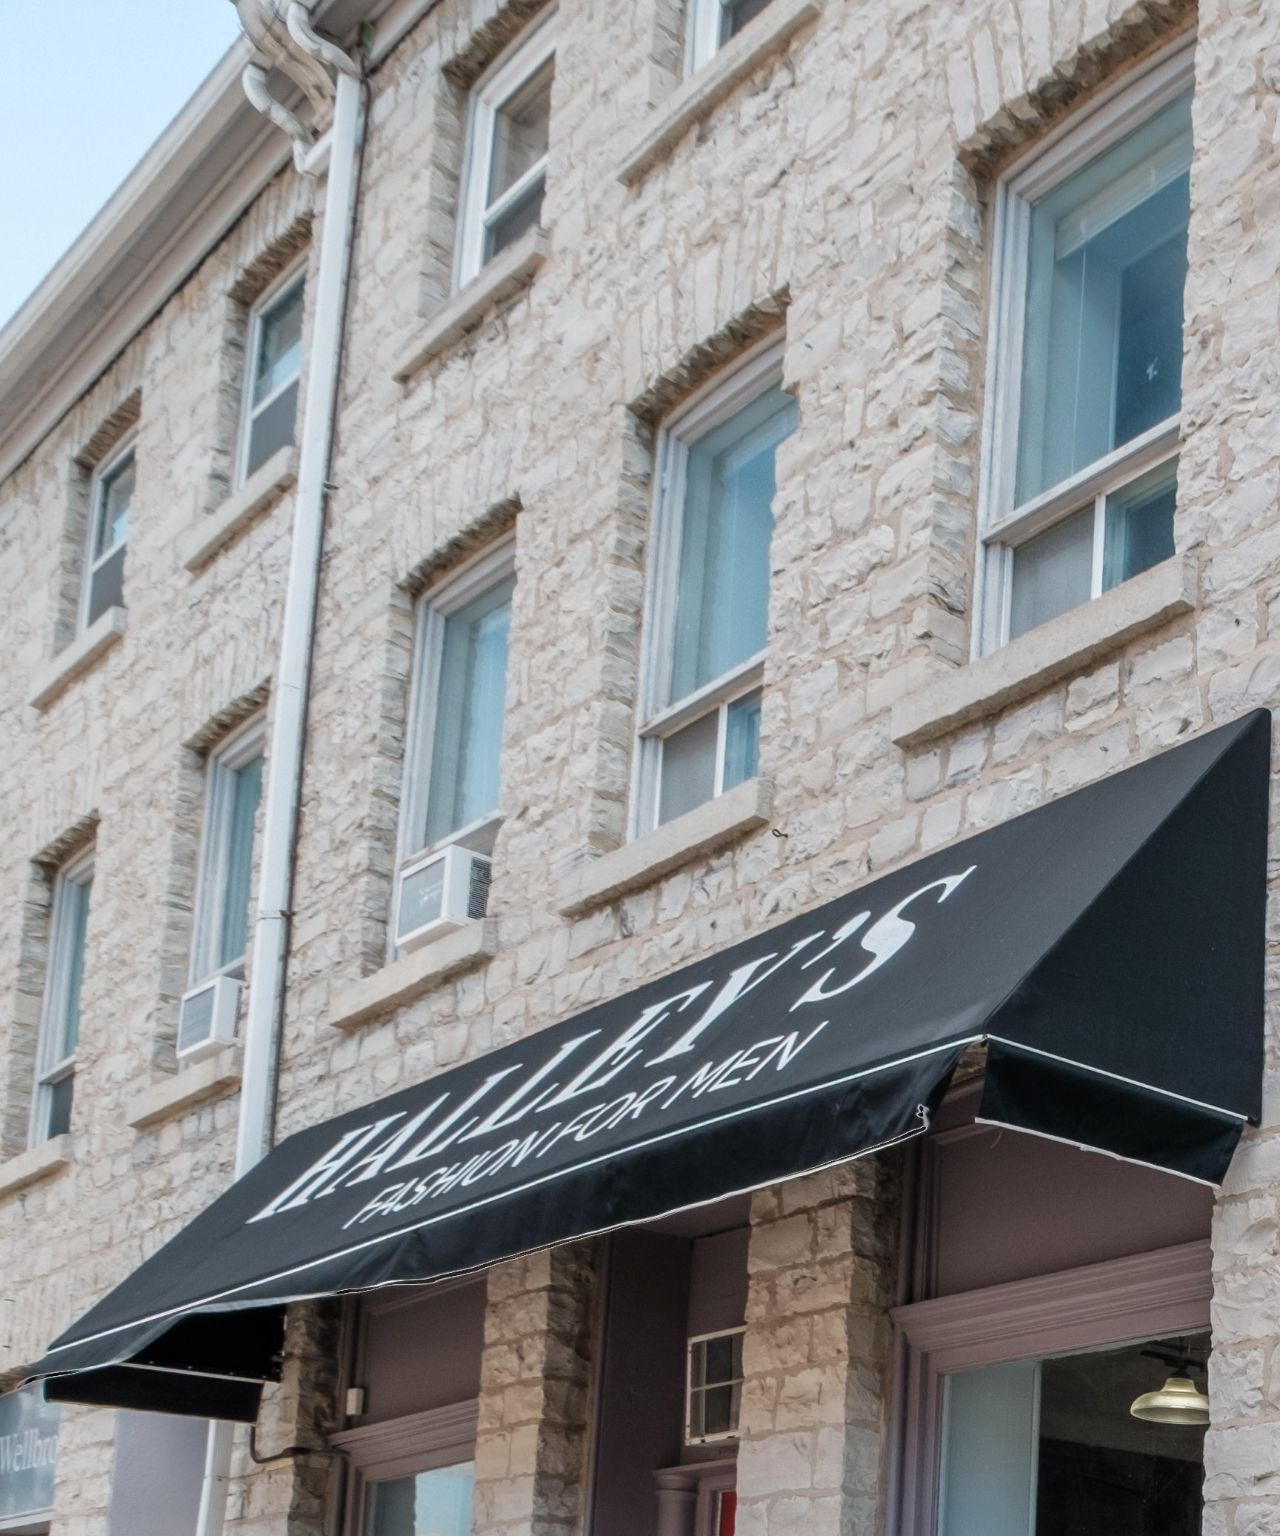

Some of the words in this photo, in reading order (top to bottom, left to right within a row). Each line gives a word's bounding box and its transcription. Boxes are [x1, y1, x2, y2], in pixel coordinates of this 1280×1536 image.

[342, 1127, 555, 1229] FASHION
[546, 1075, 672, 1160] FOR
[662, 1020, 831, 1109] MEN
